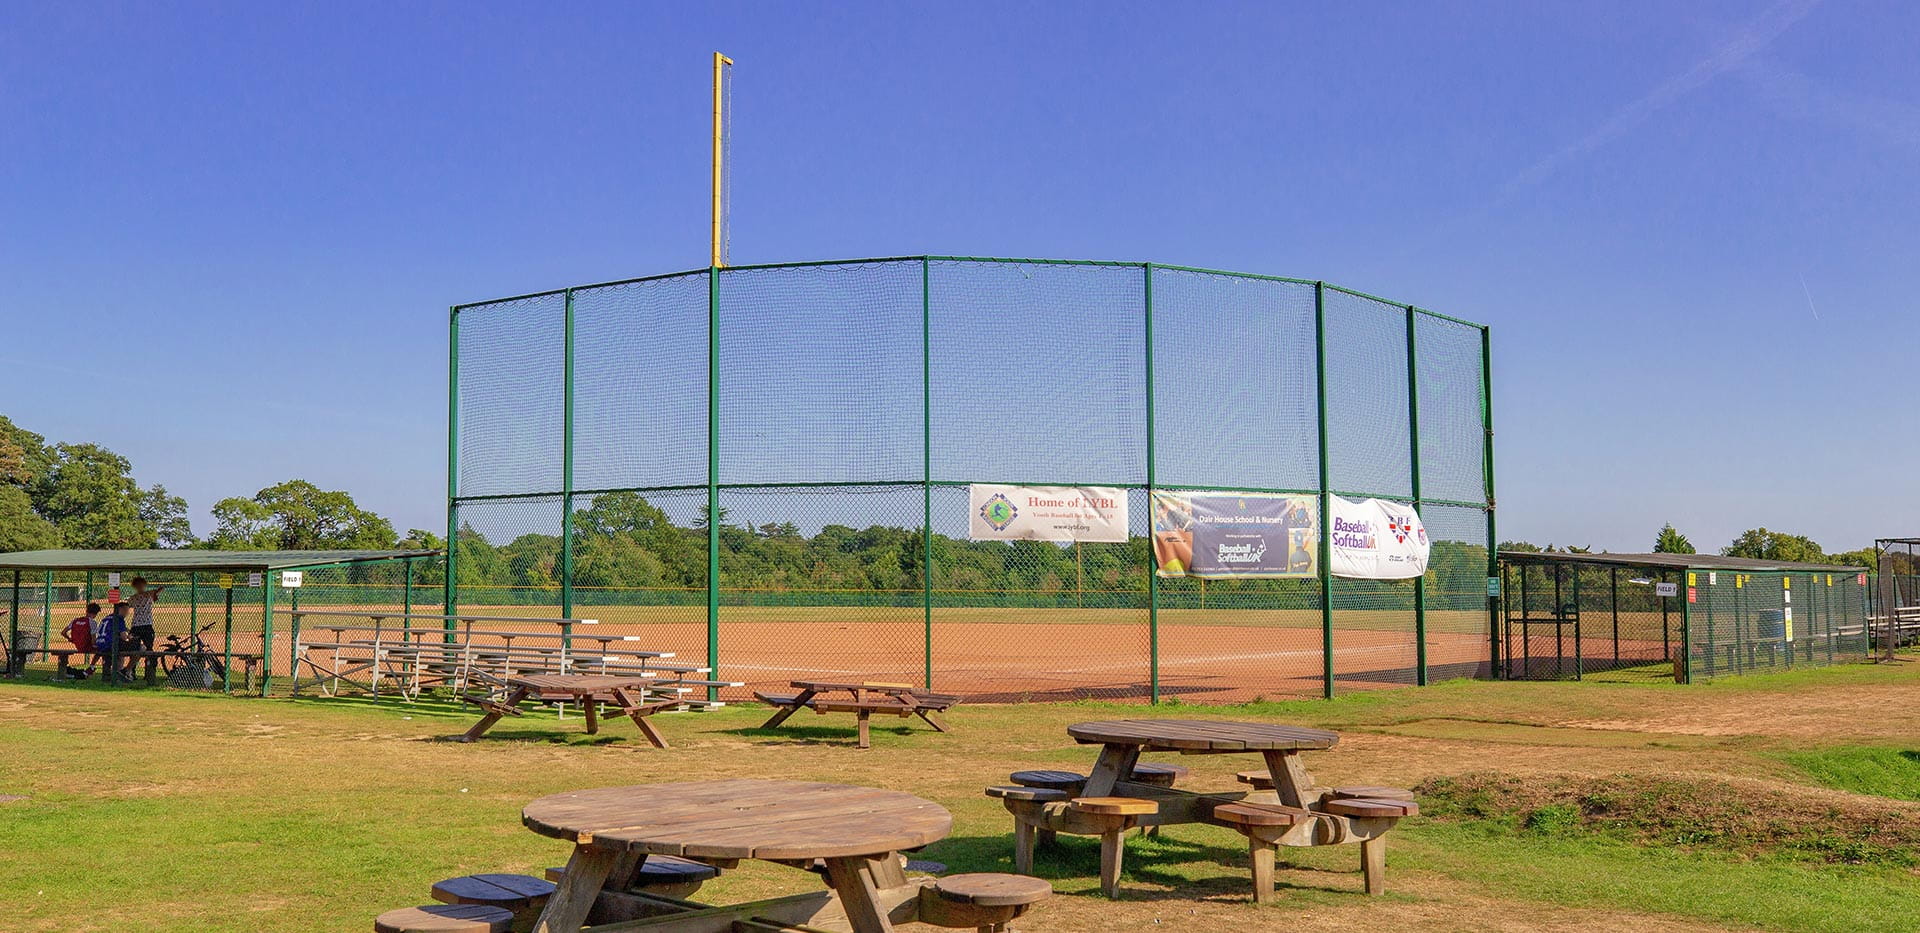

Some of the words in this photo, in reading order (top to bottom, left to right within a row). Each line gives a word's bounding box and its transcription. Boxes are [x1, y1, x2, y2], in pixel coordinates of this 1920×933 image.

[1028, 497, 1065, 507] Home
[1067, 497, 1080, 508] of
[1214, 515, 1233, 523] House
[1235, 515, 1253, 523] School
[1261, 516, 1284, 525] Nursery
[1334, 516, 1369, 534] Baseball
[1219, 544, 1251, 553] Baseball
